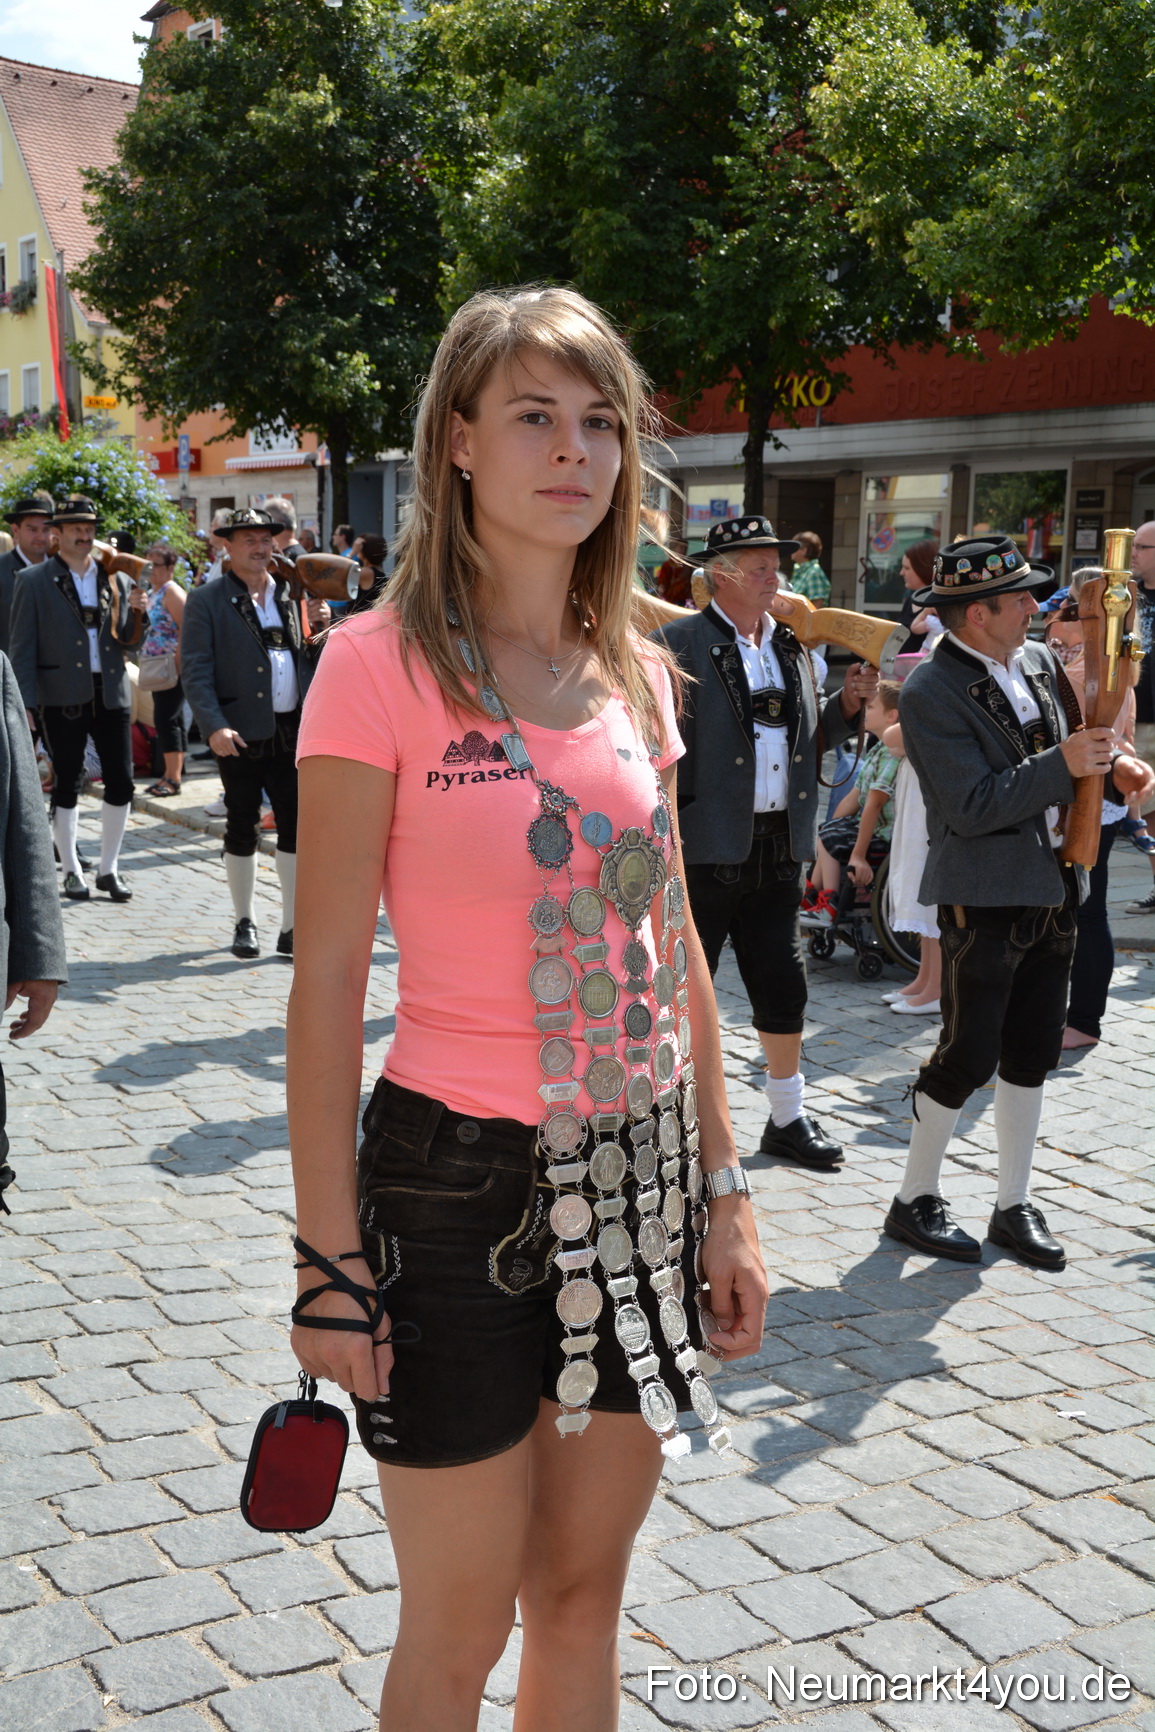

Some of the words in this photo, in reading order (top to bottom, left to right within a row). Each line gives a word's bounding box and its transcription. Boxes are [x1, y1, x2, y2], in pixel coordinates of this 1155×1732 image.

[884, 369, 986, 414] JOSEF
[999, 353, 1155, 405] ZEINING
[425, 767, 528, 792] Pyraser
